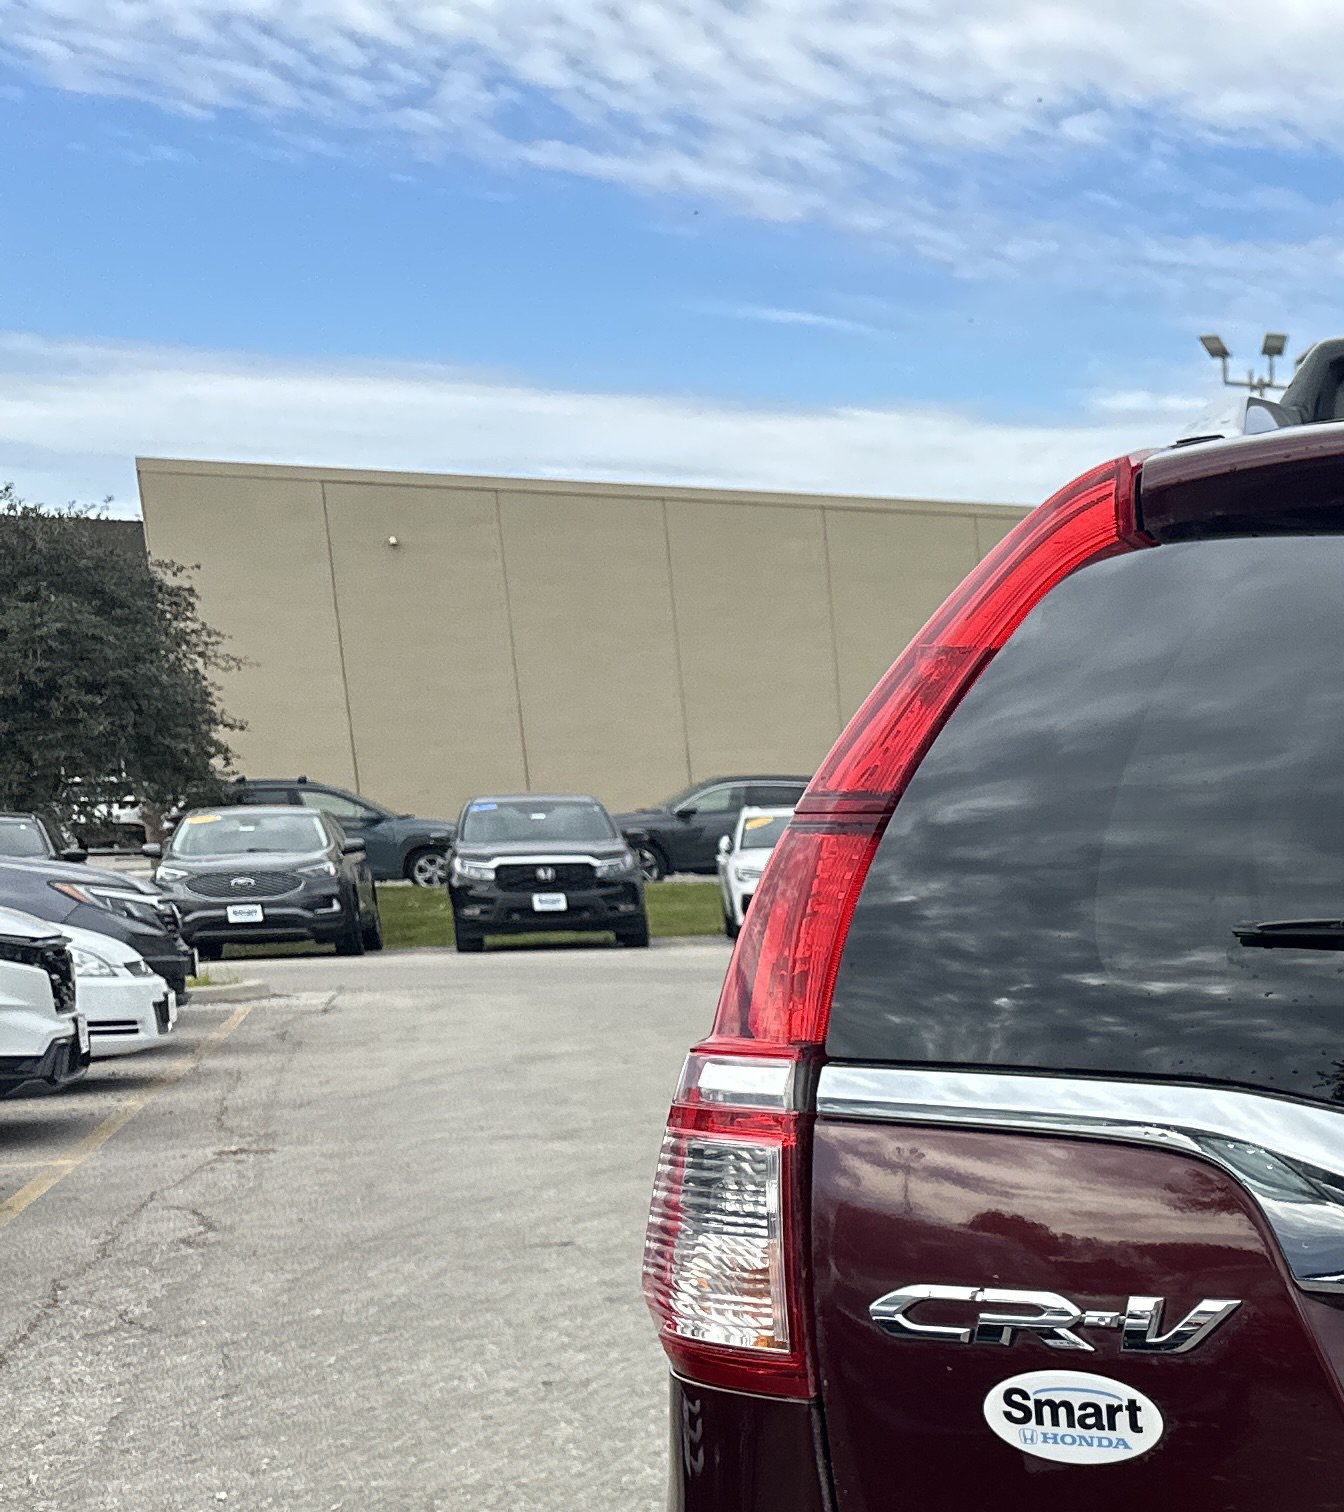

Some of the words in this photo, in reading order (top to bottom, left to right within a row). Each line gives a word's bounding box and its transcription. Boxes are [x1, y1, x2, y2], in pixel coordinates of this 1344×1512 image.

[869, 1284, 1242, 1353] CR-V
[1002, 1387, 1143, 1433] Smart
[1041, 1431, 1132, 1450] HONDA
